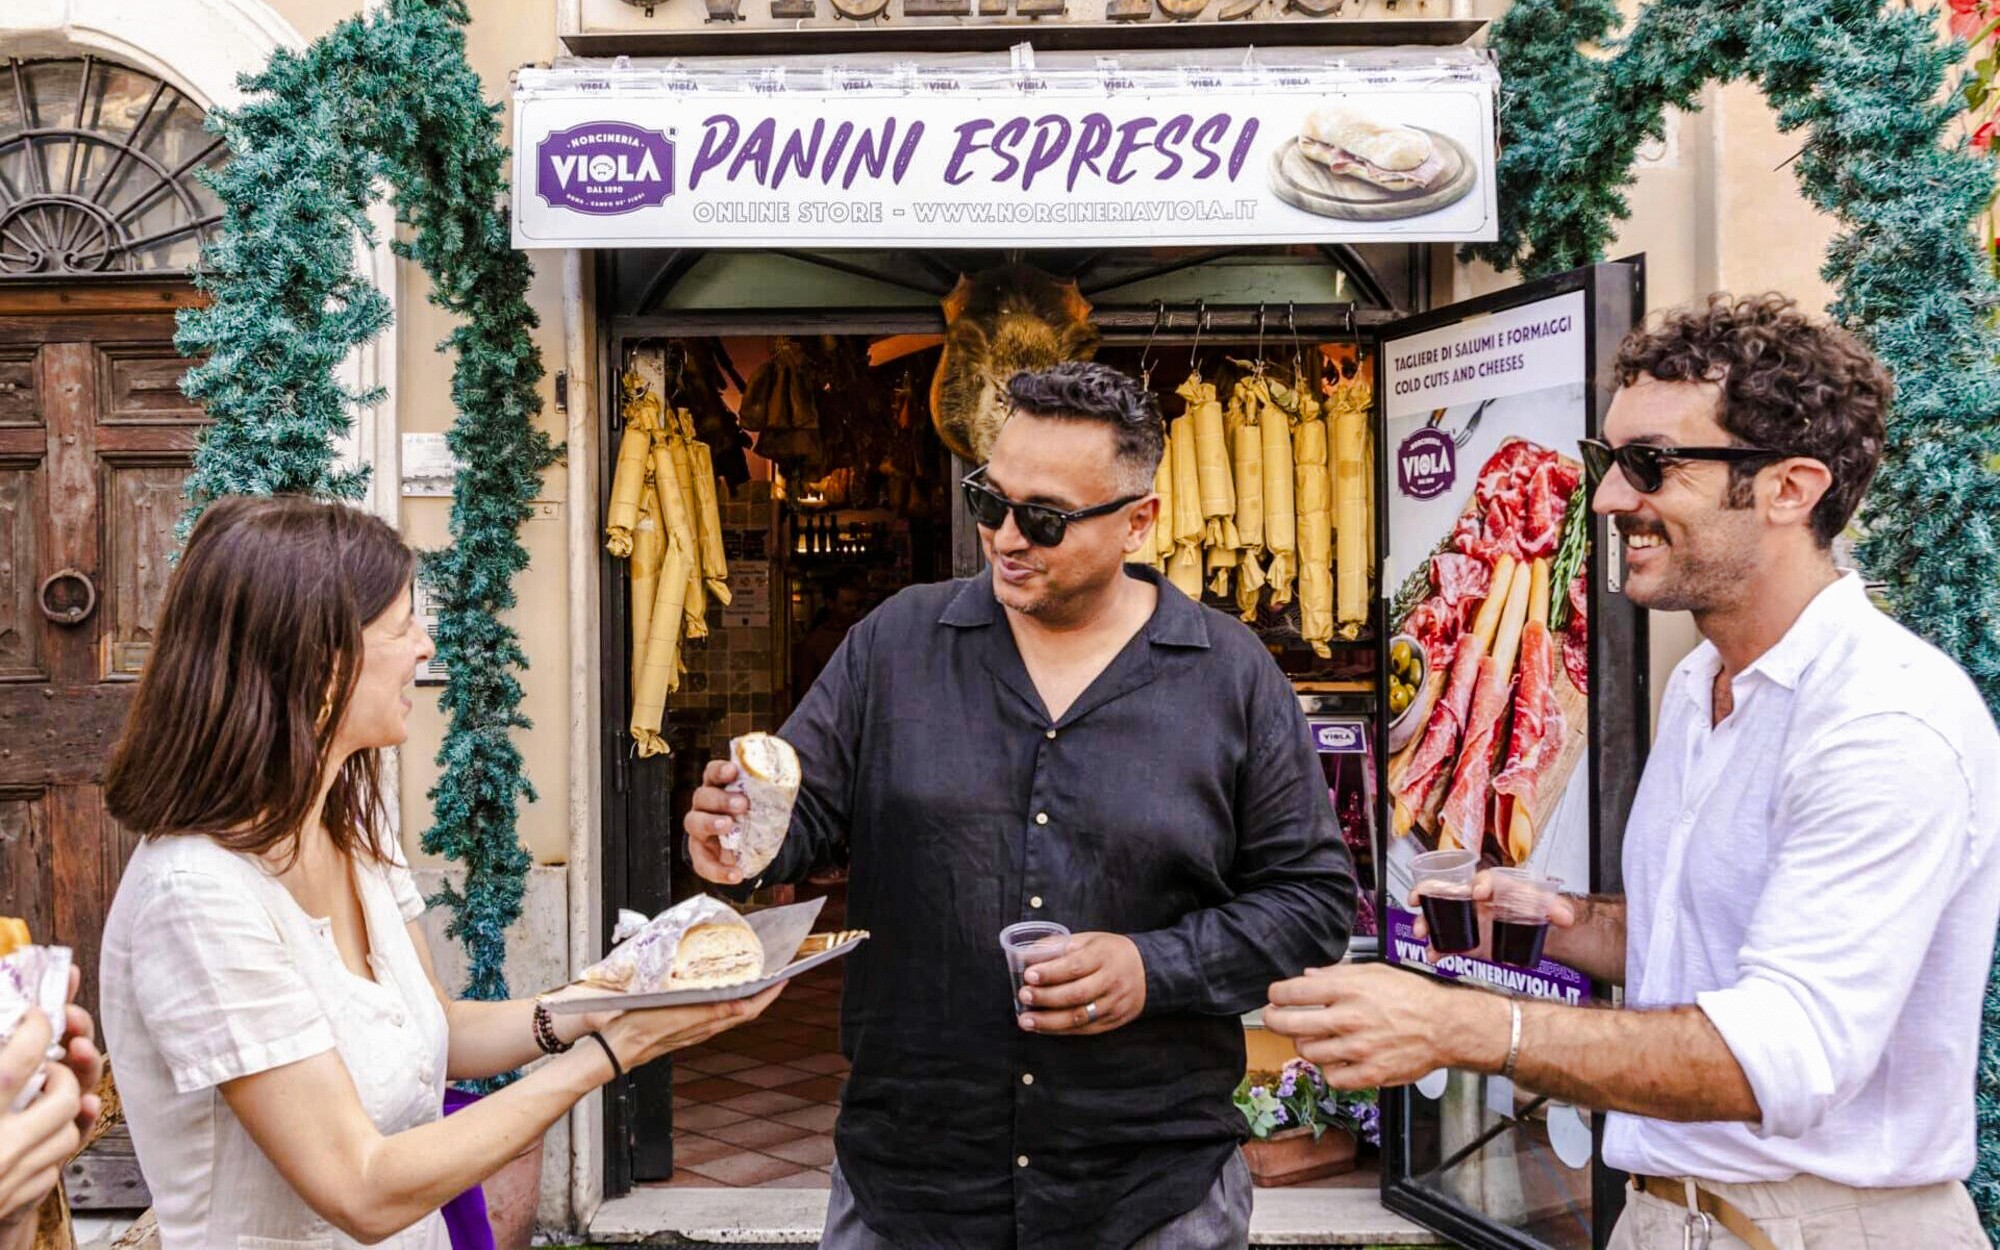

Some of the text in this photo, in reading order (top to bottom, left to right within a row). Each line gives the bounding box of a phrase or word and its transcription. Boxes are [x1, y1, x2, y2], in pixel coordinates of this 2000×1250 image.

[668, 82, 698, 91] VIOLA
[842, 81, 873, 90] VIOLA
[929, 82, 960, 91] VIOLA
[1017, 81, 1047, 90] VIOLA
[1104, 80, 1135, 90] VIOLA
[570, 133, 640, 148] NORCINERIA
[689, 113, 1260, 192] PANINI ESPRESSI
[550, 146, 662, 191] VIOLA
[586, 186, 602, 194] DAL
[693, 202, 790, 223] ONLINE
[798, 202, 883, 223] STORE
[913, 200, 1258, 223] WWW.NORCINERIAVIOLA.IT
[1395, 316, 1572, 371] TAGLIERE DI SALUMI E FORMAGGI
[1395, 354, 1525, 395] COLD CUTS AND CHEESES
[1402, 445, 1451, 484] VIOLA
